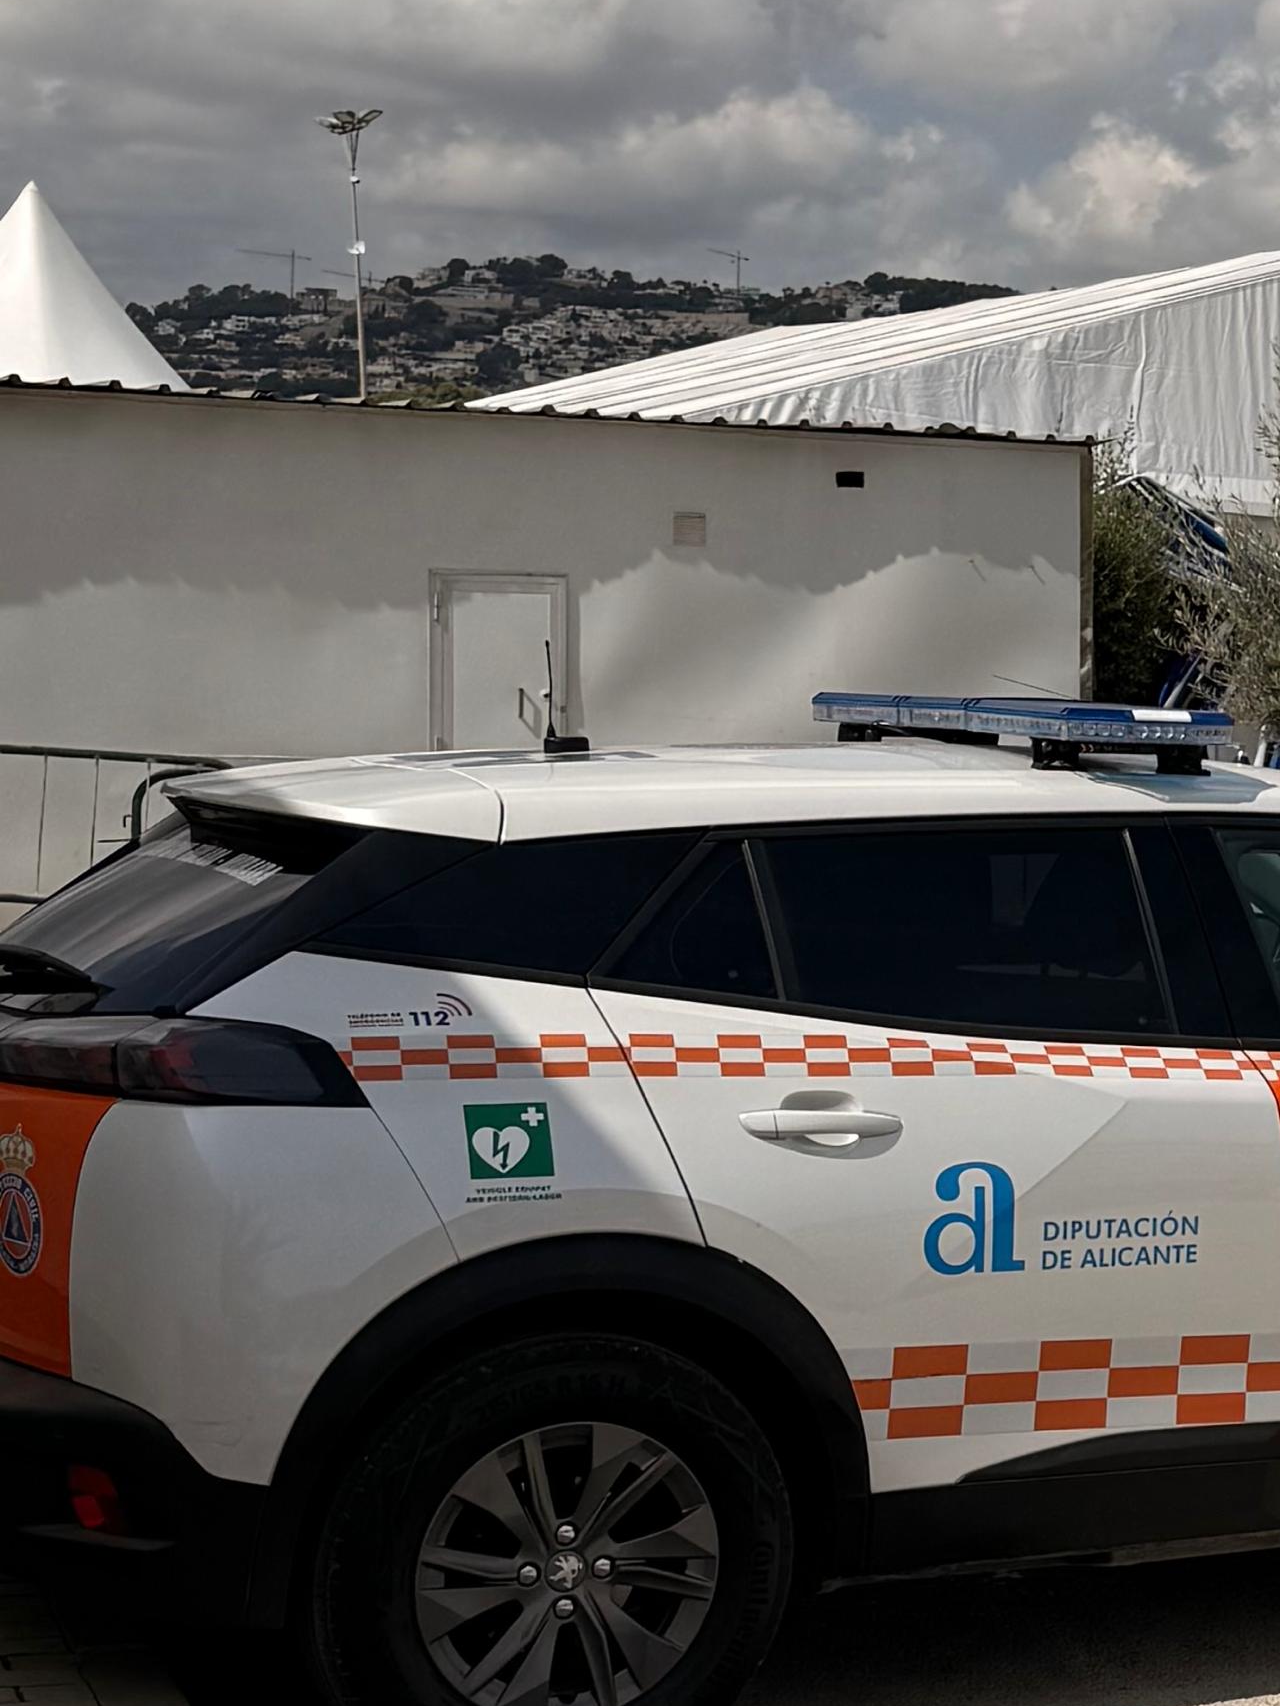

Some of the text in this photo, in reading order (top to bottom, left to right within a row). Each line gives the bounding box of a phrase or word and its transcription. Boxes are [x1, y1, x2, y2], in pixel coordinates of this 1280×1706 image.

[408, 1011, 450, 1026] 112
[1043, 1209, 1199, 1242] DIPUTACIÓN
[1042, 1244, 1198, 1271] DE ALICANTE
